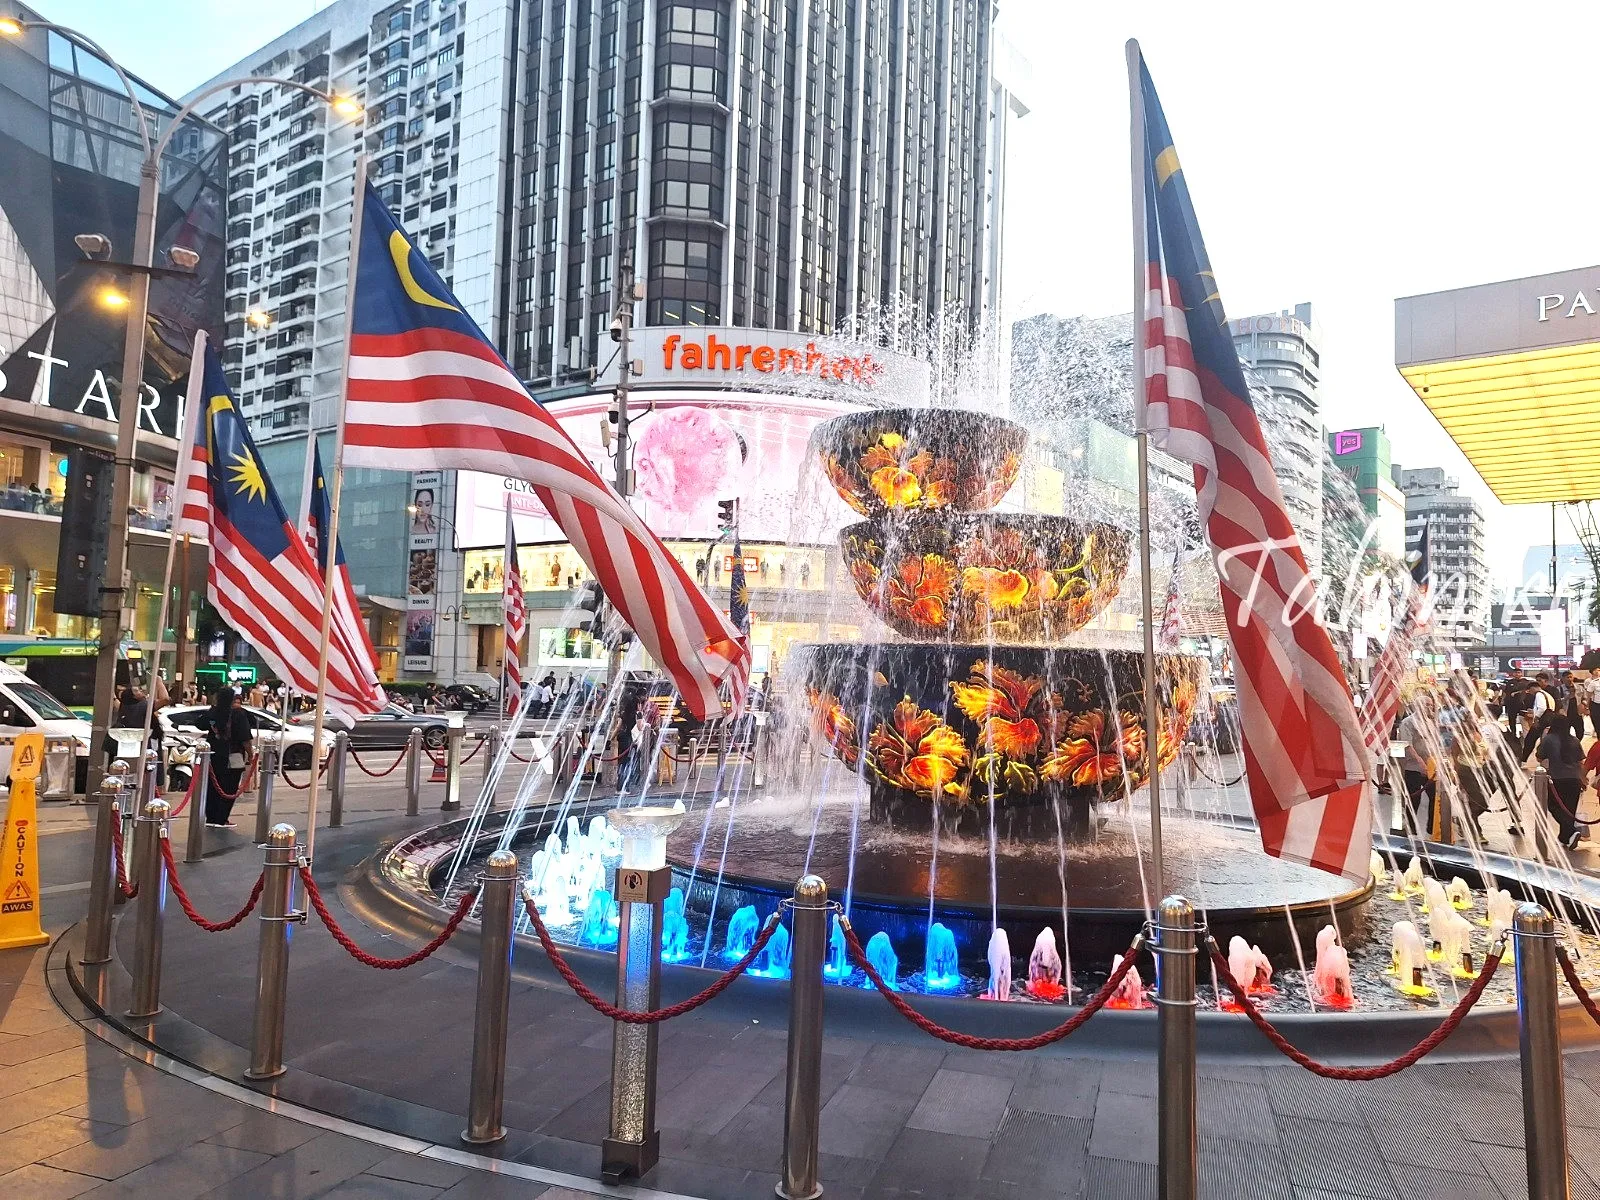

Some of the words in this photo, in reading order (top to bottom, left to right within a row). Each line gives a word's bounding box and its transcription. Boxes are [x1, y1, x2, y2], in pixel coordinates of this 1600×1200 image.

[1537, 287, 1600, 322] PA
[0, 344, 187, 440] TAR
[1342, 438, 1356, 446] yes
[416, 477, 438, 485] FASHION
[15, 826, 27, 877] CAUTION
[3, 901, 33, 913] AWAS
